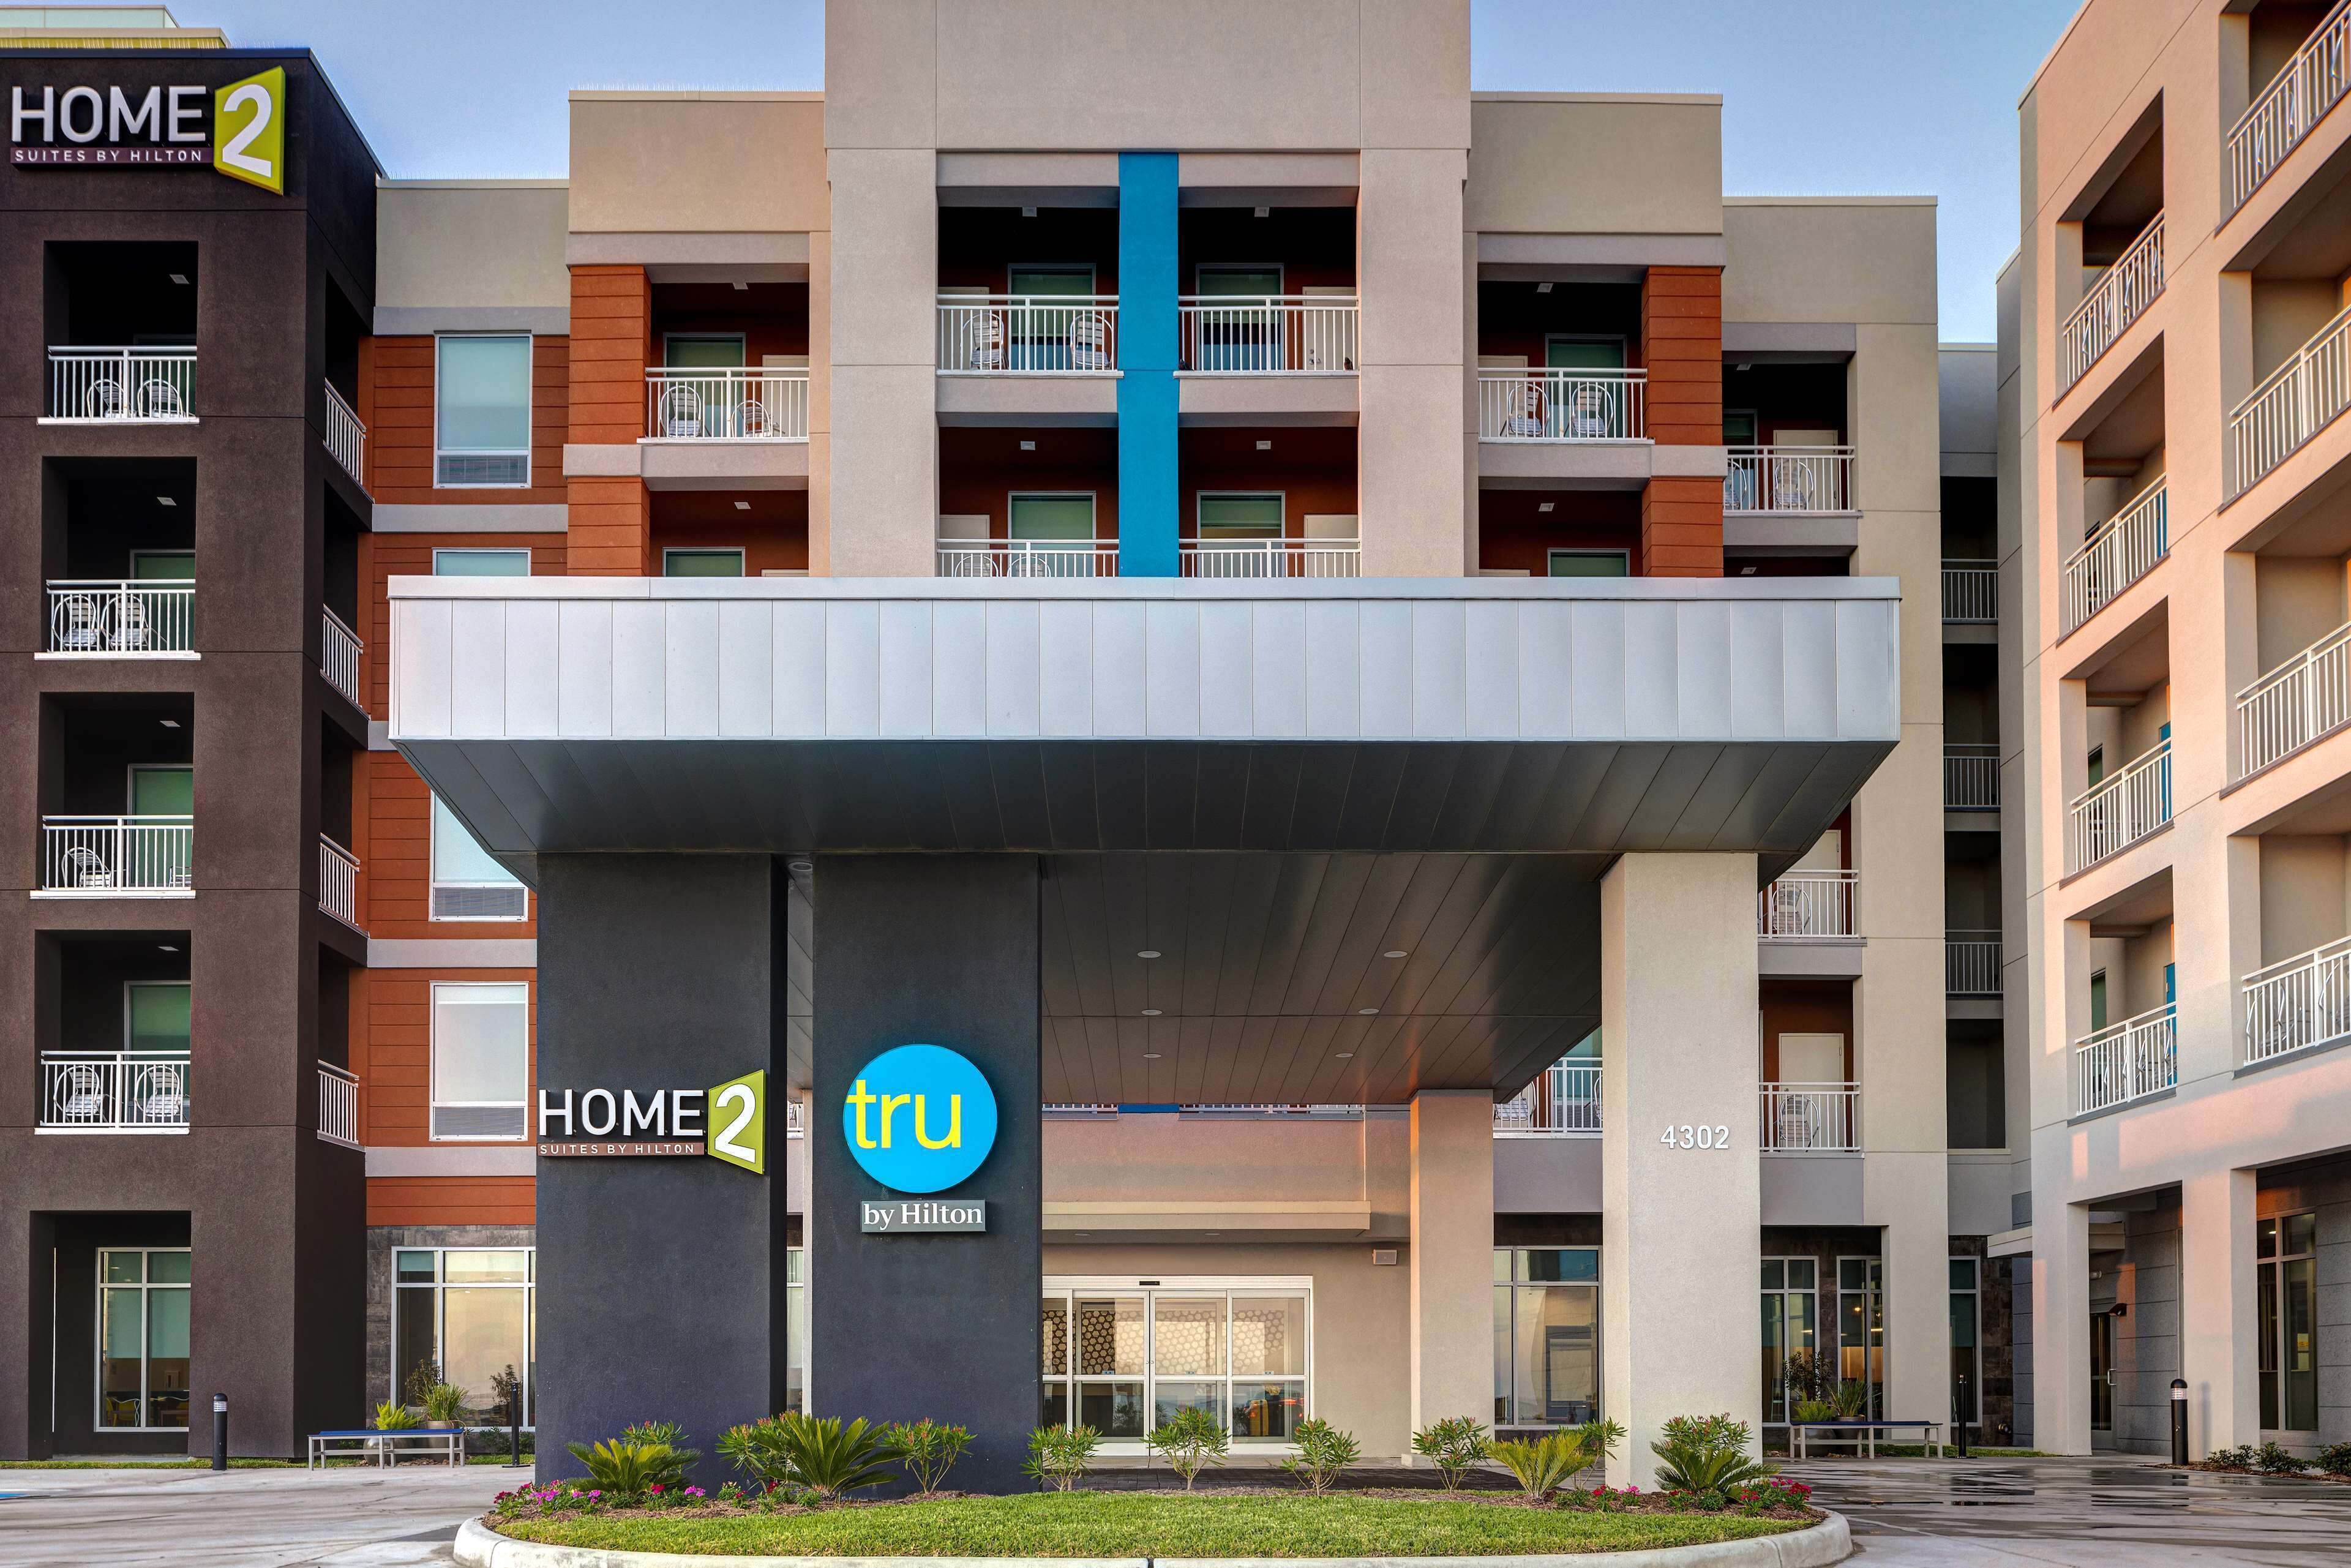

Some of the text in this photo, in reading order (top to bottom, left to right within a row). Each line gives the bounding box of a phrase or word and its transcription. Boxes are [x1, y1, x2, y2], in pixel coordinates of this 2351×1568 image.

[11, 84, 272, 178] HOME 2
[15, 150, 201, 162] SUITES BY HILTON
[539, 1083, 756, 1163] HOME 2
[846, 1079, 961, 1149] tru
[540, 1143, 694, 1154] SUITES BY HILTON
[1660, 1125, 1729, 1149] 4302
[863, 1202, 982, 1230] by Hilton
